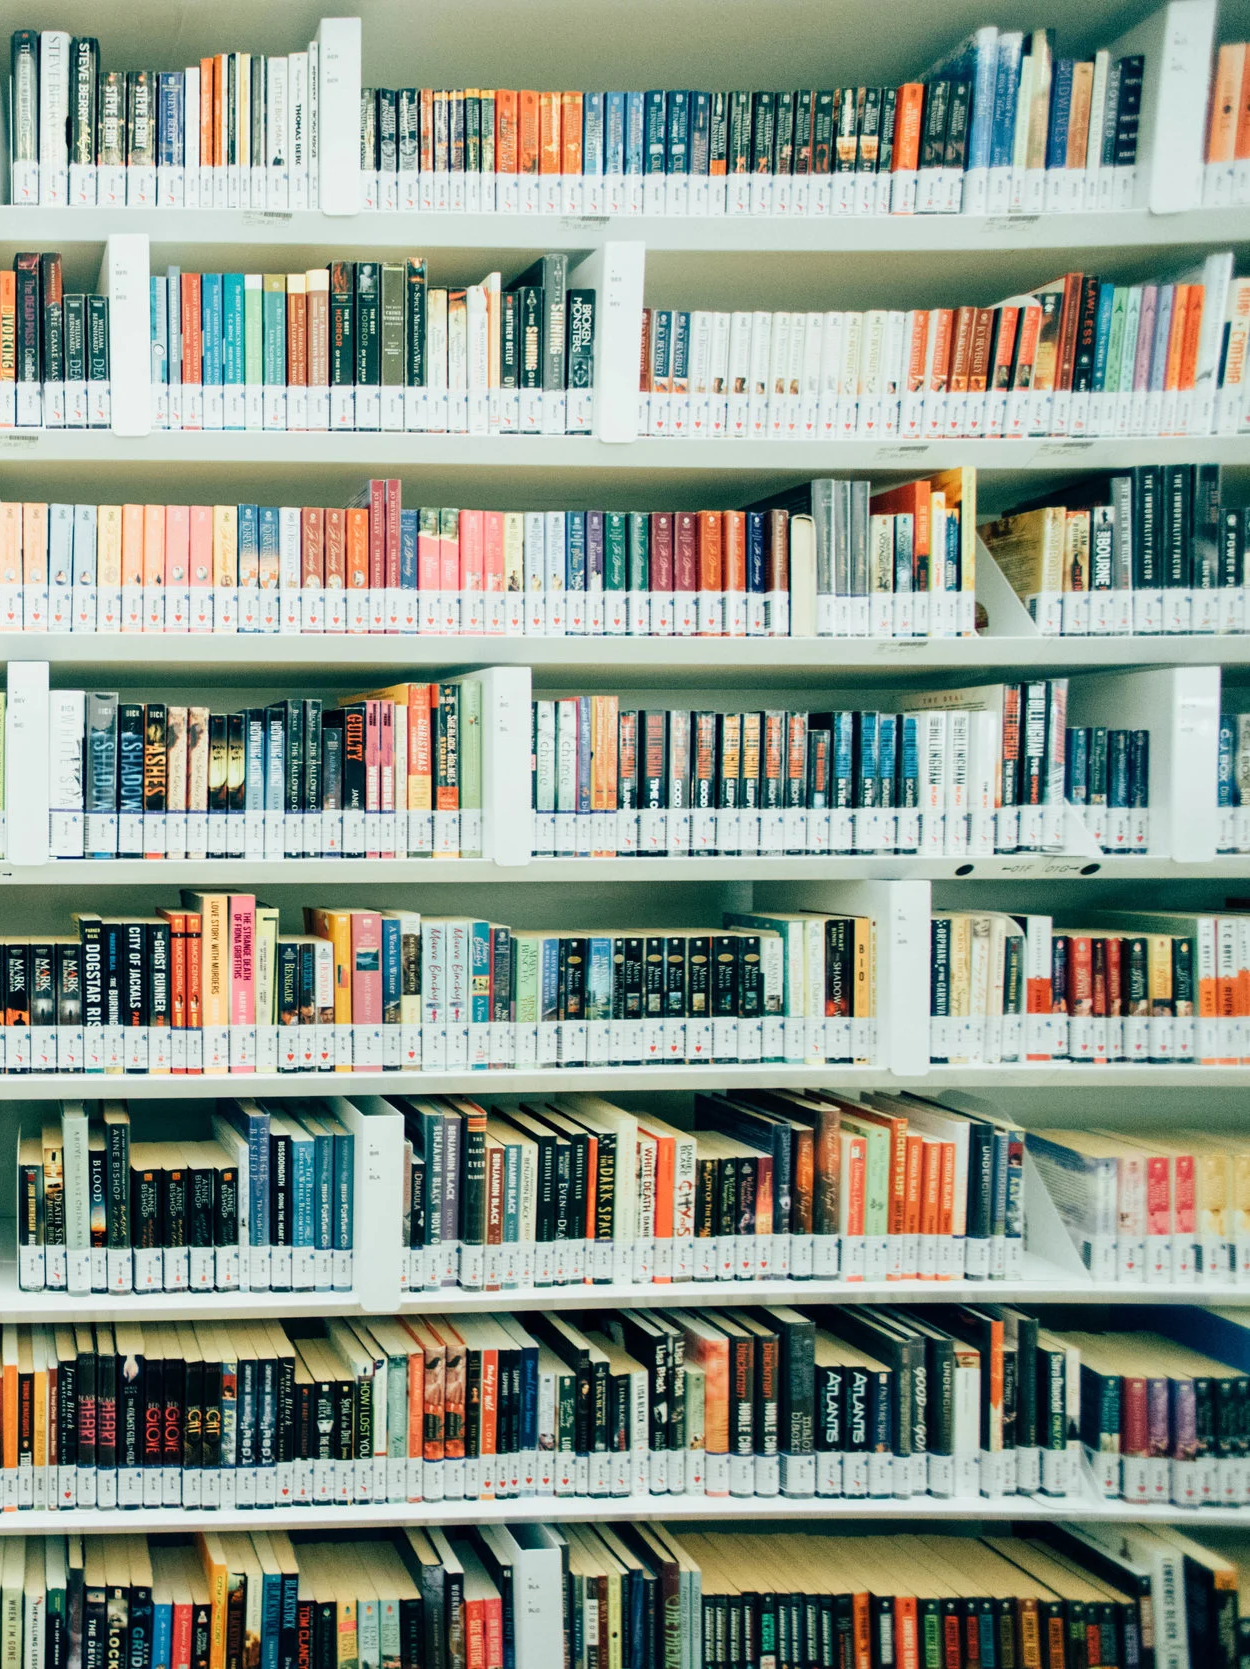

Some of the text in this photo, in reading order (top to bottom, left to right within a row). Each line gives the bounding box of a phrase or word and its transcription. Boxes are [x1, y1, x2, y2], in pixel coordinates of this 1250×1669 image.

[47, 36, 62, 128] STEVE BERRY
[78, 44, 91, 122] STEVE BERRY
[1055, 71, 1067, 143] MIDWIVES
[105, 86, 119, 148] STEVE BERRY
[135, 86, 150, 148] STEVE BERRY
[360, 308, 368, 346] HORROR
[413, 292, 421, 315] SPICE
[505, 310, 513, 337] MATTHEW
[571, 297, 592, 352] BROKEN MONSTERS
[1082, 279, 1097, 346] LAWLESS
[92, 312, 100, 354] BERNHARDT
[525, 326, 538, 370] SHINING
[550, 304, 564, 354] SHINING
[1172, 474, 1182, 580] THE IMMORTALITY FACTOR
[1095, 539, 1112, 586] BOURNE
[346, 714, 363, 762] GUILTY
[417, 719, 428, 772] CHRISTMAS
[439, 737, 448, 776] STORIES
[446, 715, 457, 783] SHERLOCK HOLMES
[646, 727, 663, 777] BILLINGHAM
[1026, 699, 1045, 774] BILLINGHAM THE
[144, 744, 166, 796] ASHES
[129, 927, 142, 1008] CITY OF JACKALS
[210, 901, 220, 994] LOVE STORY, WITH MURDERS
[233, 914, 244, 979] OF FIONA GRIFFITHS
[242, 912, 252, 980] THE STRANGE DEATH
[452, 928, 464, 1002] Maeve Binchy
[67, 960, 78, 992] MARK
[85, 944, 100, 1004] DOGSTAR
[154, 940, 166, 1012] GHOST RUNNER
[284, 963, 295, 1003] RENEGADE
[108, 990, 118, 1025] BURNING
[112, 1129, 120, 1200] ANNE BISHOP
[277, 1141, 286, 1186] BISSOONDATH
[508, 1147, 517, 1214] BENJAMIN BLACK
[491, 1153, 501, 1225] BENJAMIN BLACK
[360, 1380, 371, 1404] HOW
[655, 1345, 665, 1393] Lisa Black
[762, 1342, 774, 1398] blackman
[100, 1401, 116, 1447] HEART
[164, 1406, 180, 1452] GLOVE
[206, 1410, 220, 1435] CAT
[360, 1414, 372, 1436] LOST
[852, 1371, 868, 1442] ATLANTIS
[360, 1438, 372, 1458] YOU
[8, 1600, 16, 1622] WHEN
[283, 1580, 296, 1628] BLACKSTOCK
[8, 1640, 16, 1660] GONE
[470, 1620, 482, 1666] SIZE MATTERS
